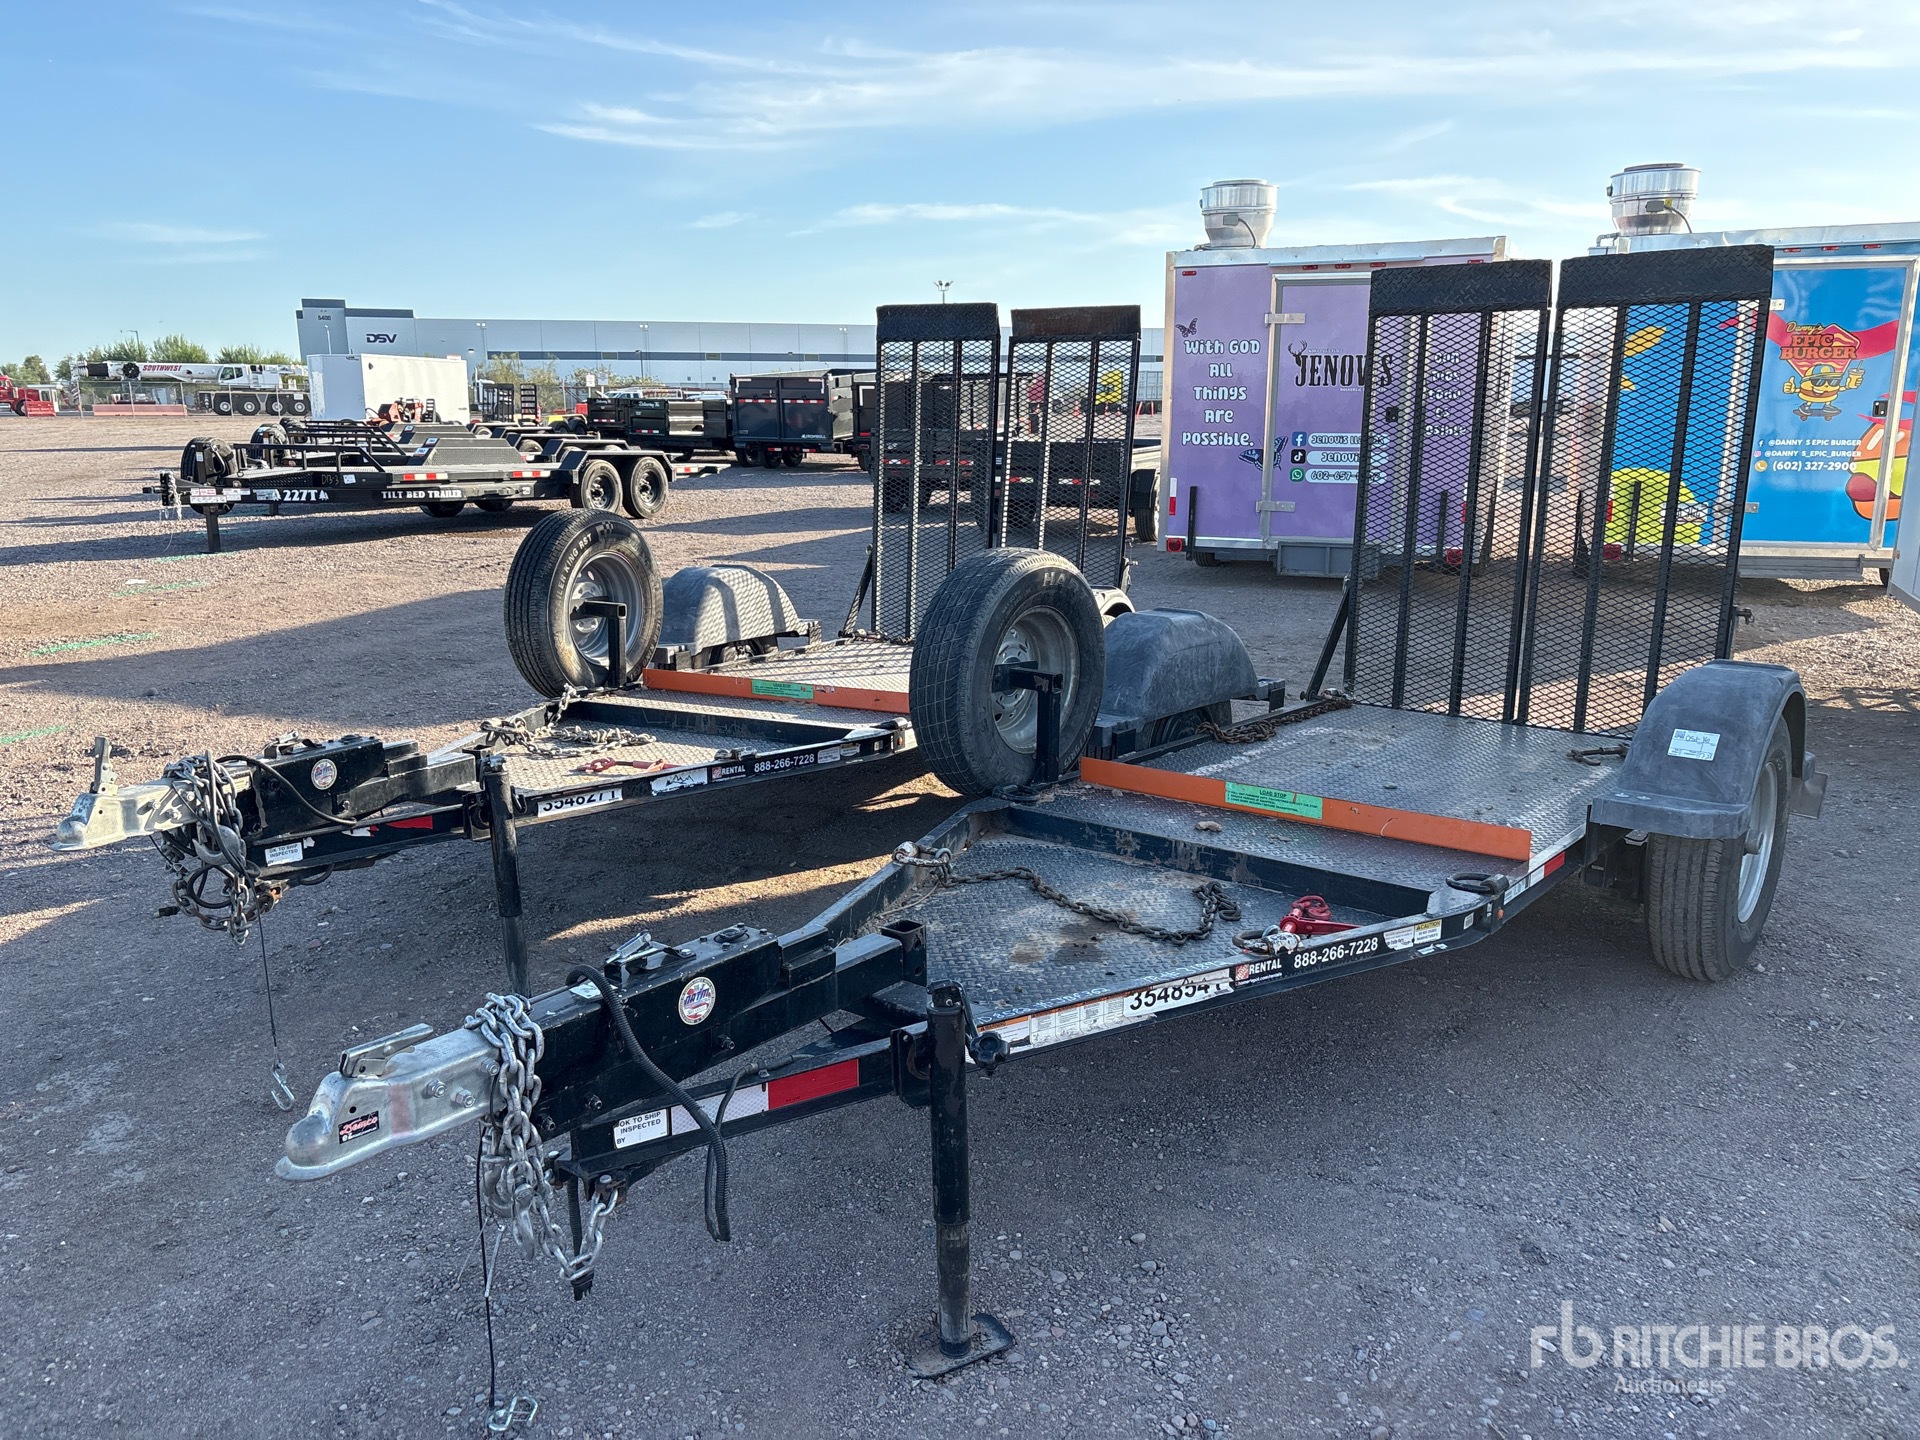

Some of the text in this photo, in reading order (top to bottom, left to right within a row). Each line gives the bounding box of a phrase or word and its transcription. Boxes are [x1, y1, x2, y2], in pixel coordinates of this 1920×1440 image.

[1787, 321, 1825, 335] Danny's
[366, 334, 397, 343] DSV
[1791, 335, 1834, 347] EPIC
[1184, 340, 1261, 354] With GOD
[1780, 346, 1857, 360] BURGER
[1194, 386, 1247, 400] Things
[1321, 452, 1362, 463] Jenovi
[1773, 461, 1857, 472] (602) 327-2900
[283, 489, 318, 501] 227T
[428, 490, 462, 498] TRAILER
[563, 548, 579, 573] KING
[578, 533, 592, 549] RST
[721, 765, 746, 775] RENTAL
[754, 754, 815, 772] 888-266-7228
[1259, 789, 1273, 797] LOAD
[1273, 791, 1287, 799] STOP
[270, 849, 298, 858] INSPECTED
[1421, 920, 1441, 930] CAUTION
[1249, 959, 1282, 975] RENTAL
[1294, 937, 1378, 969] 888-266-7228
[644, 1112, 661, 1120] SHIP
[620, 1119, 661, 1134] INSPECTED
